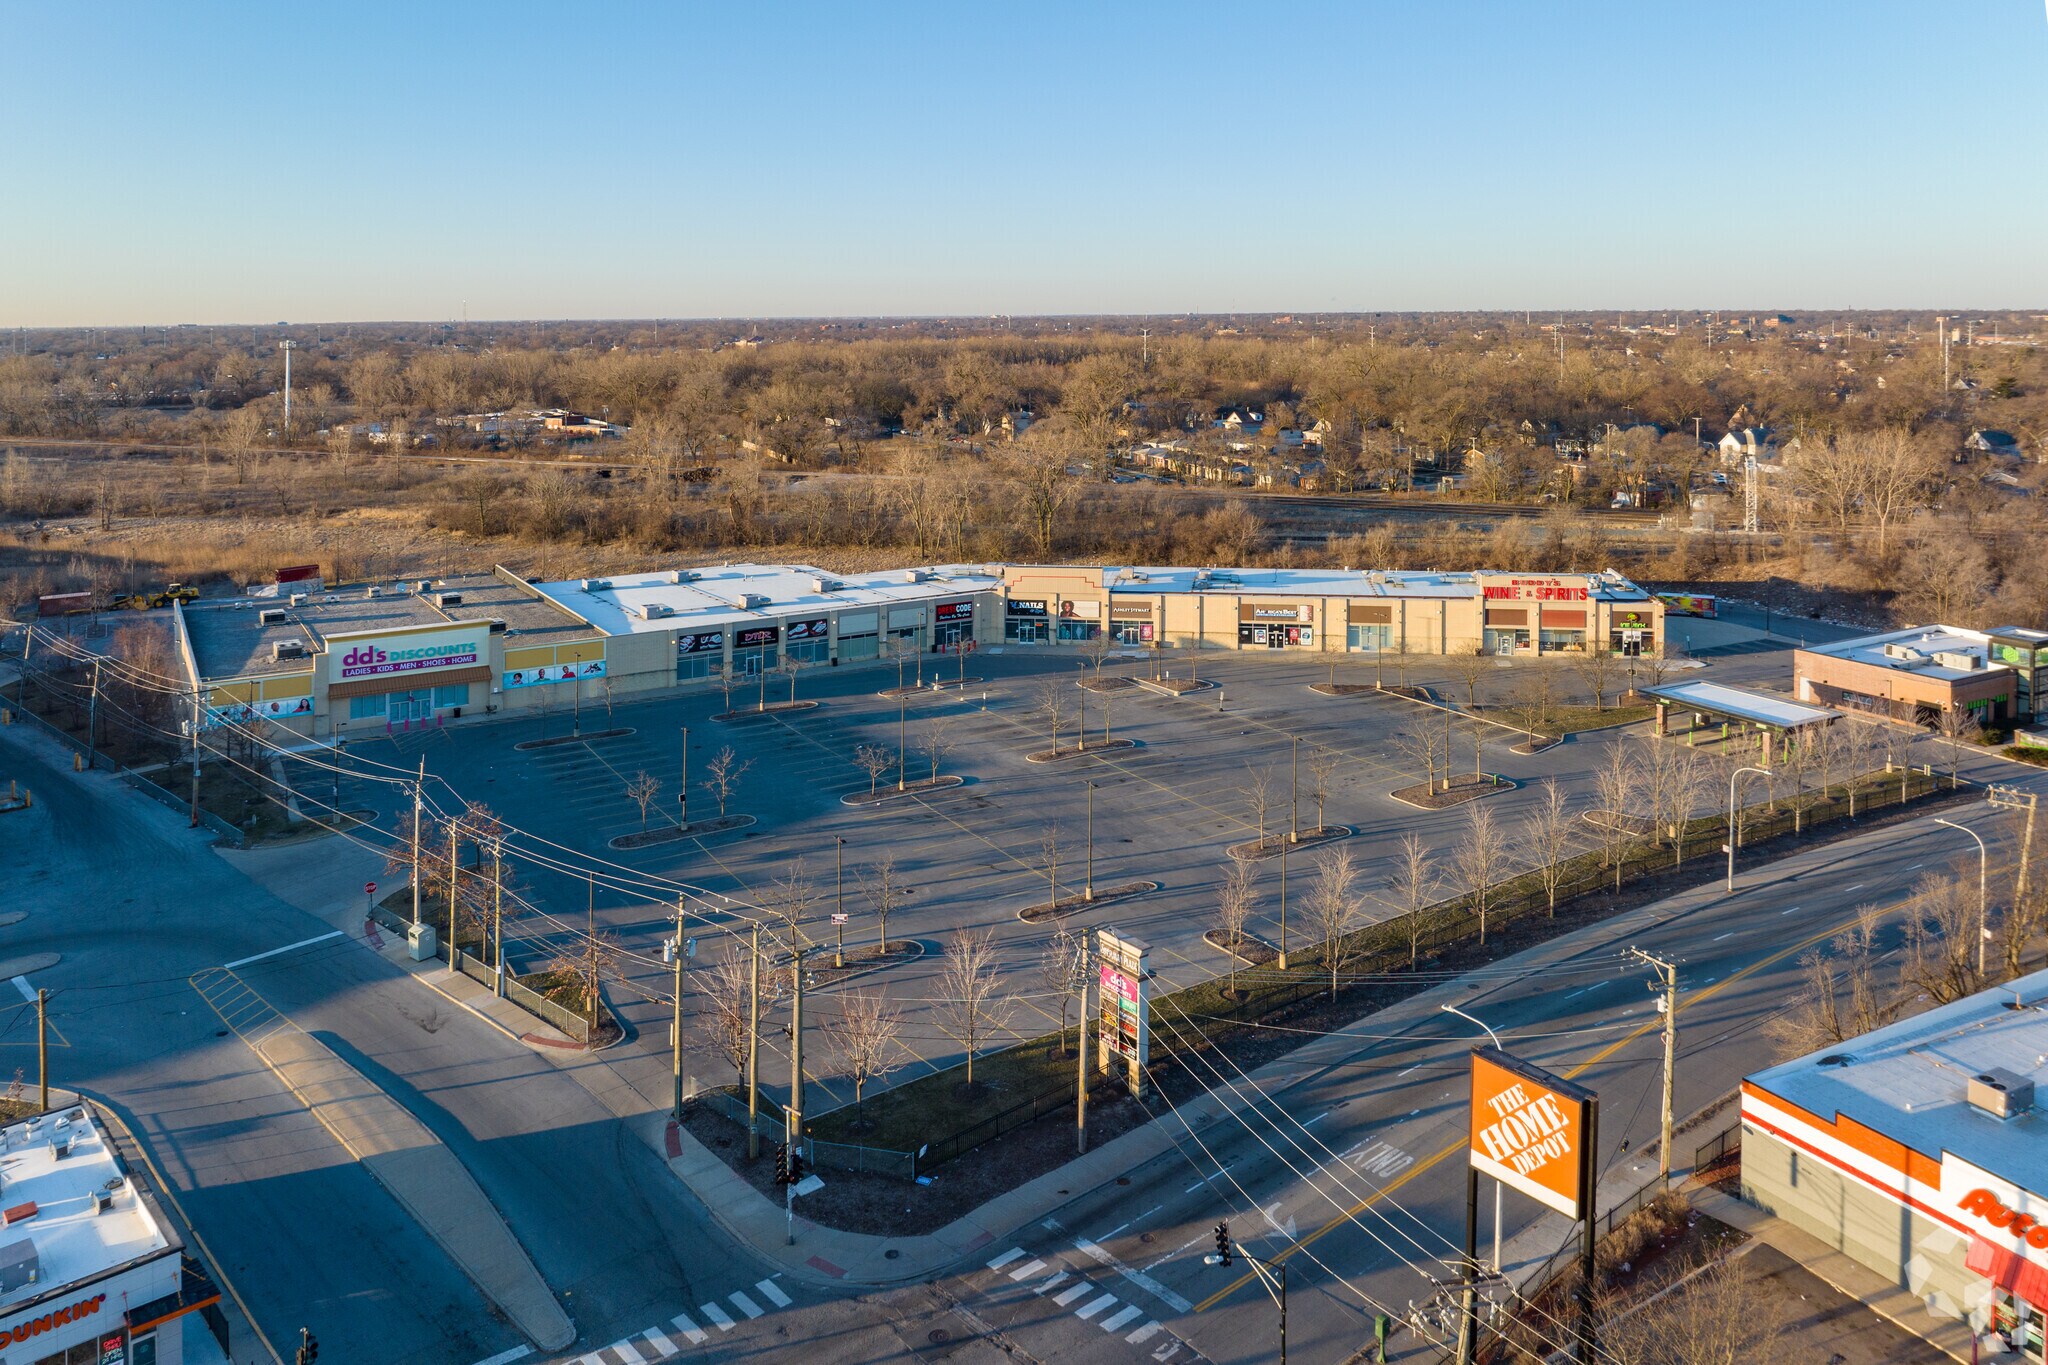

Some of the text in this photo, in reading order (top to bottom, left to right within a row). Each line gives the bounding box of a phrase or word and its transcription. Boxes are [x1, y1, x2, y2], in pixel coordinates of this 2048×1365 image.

[1483, 587, 1520, 600] WINE
[1536, 587, 1588, 600] SPIRITS
[1512, 578, 1561, 586] BUDDY'S
[343, 642, 477, 667] dd's DISCOUNTS
[346, 666, 371, 676] LADIES
[377, 665, 394, 673] KIDS
[400, 662, 417, 670] MEN
[422, 659, 446, 667] SHOES
[1488, 1083, 1530, 1118] THE
[1479, 1093, 1570, 1162] HOME
[1511, 1131, 1571, 1176] DEPOT
